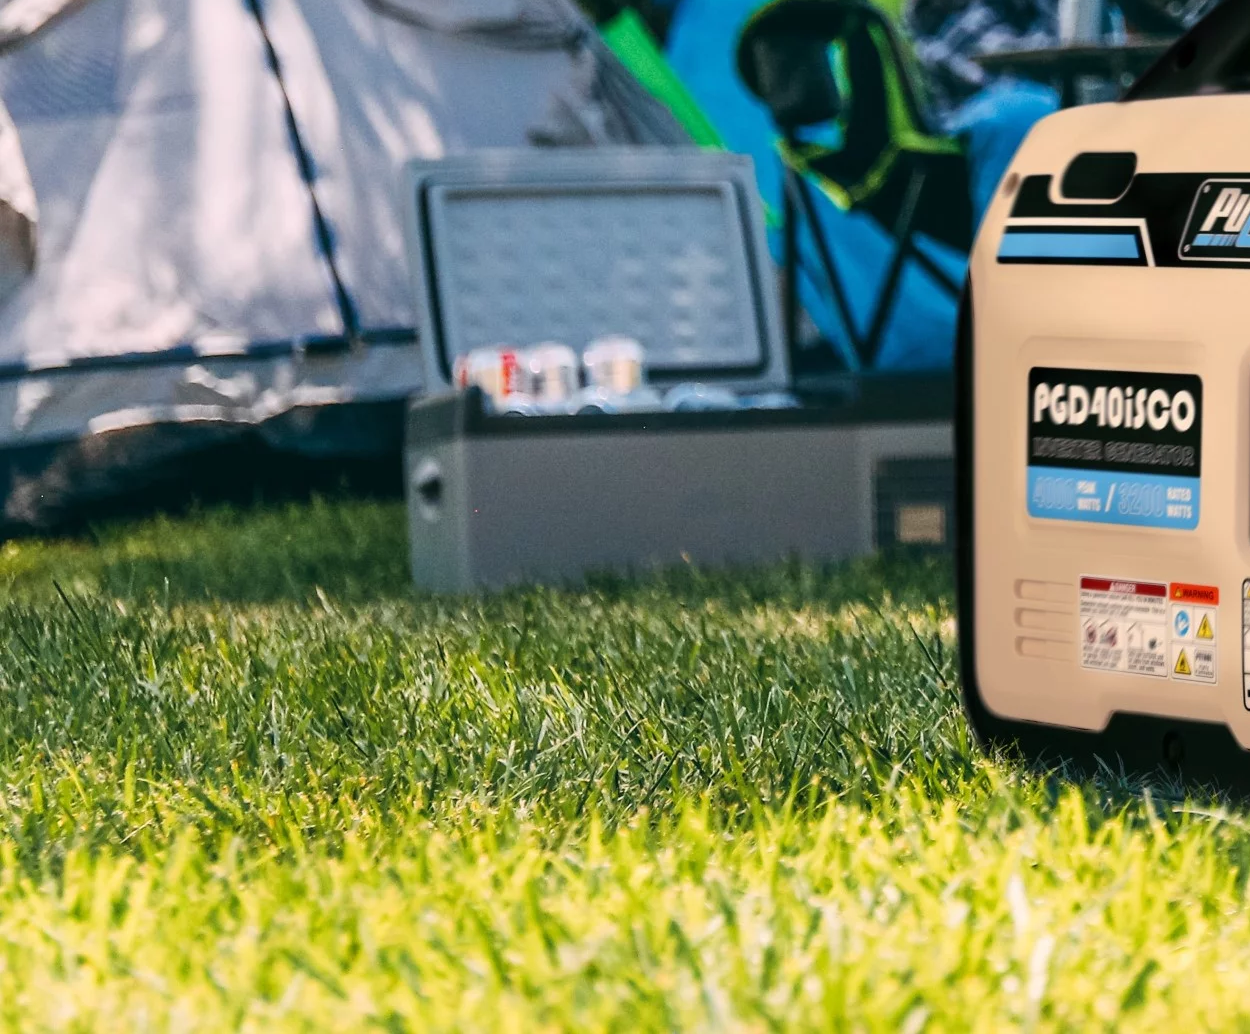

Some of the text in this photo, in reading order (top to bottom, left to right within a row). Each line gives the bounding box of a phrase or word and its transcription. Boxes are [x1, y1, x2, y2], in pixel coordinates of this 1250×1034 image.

[1077, 498, 1101, 511] WATTS
[1119, 482, 1165, 516] 3200
[1167, 505, 1192, 519] WATTS
[1183, 589, 1214, 601] WARNING
